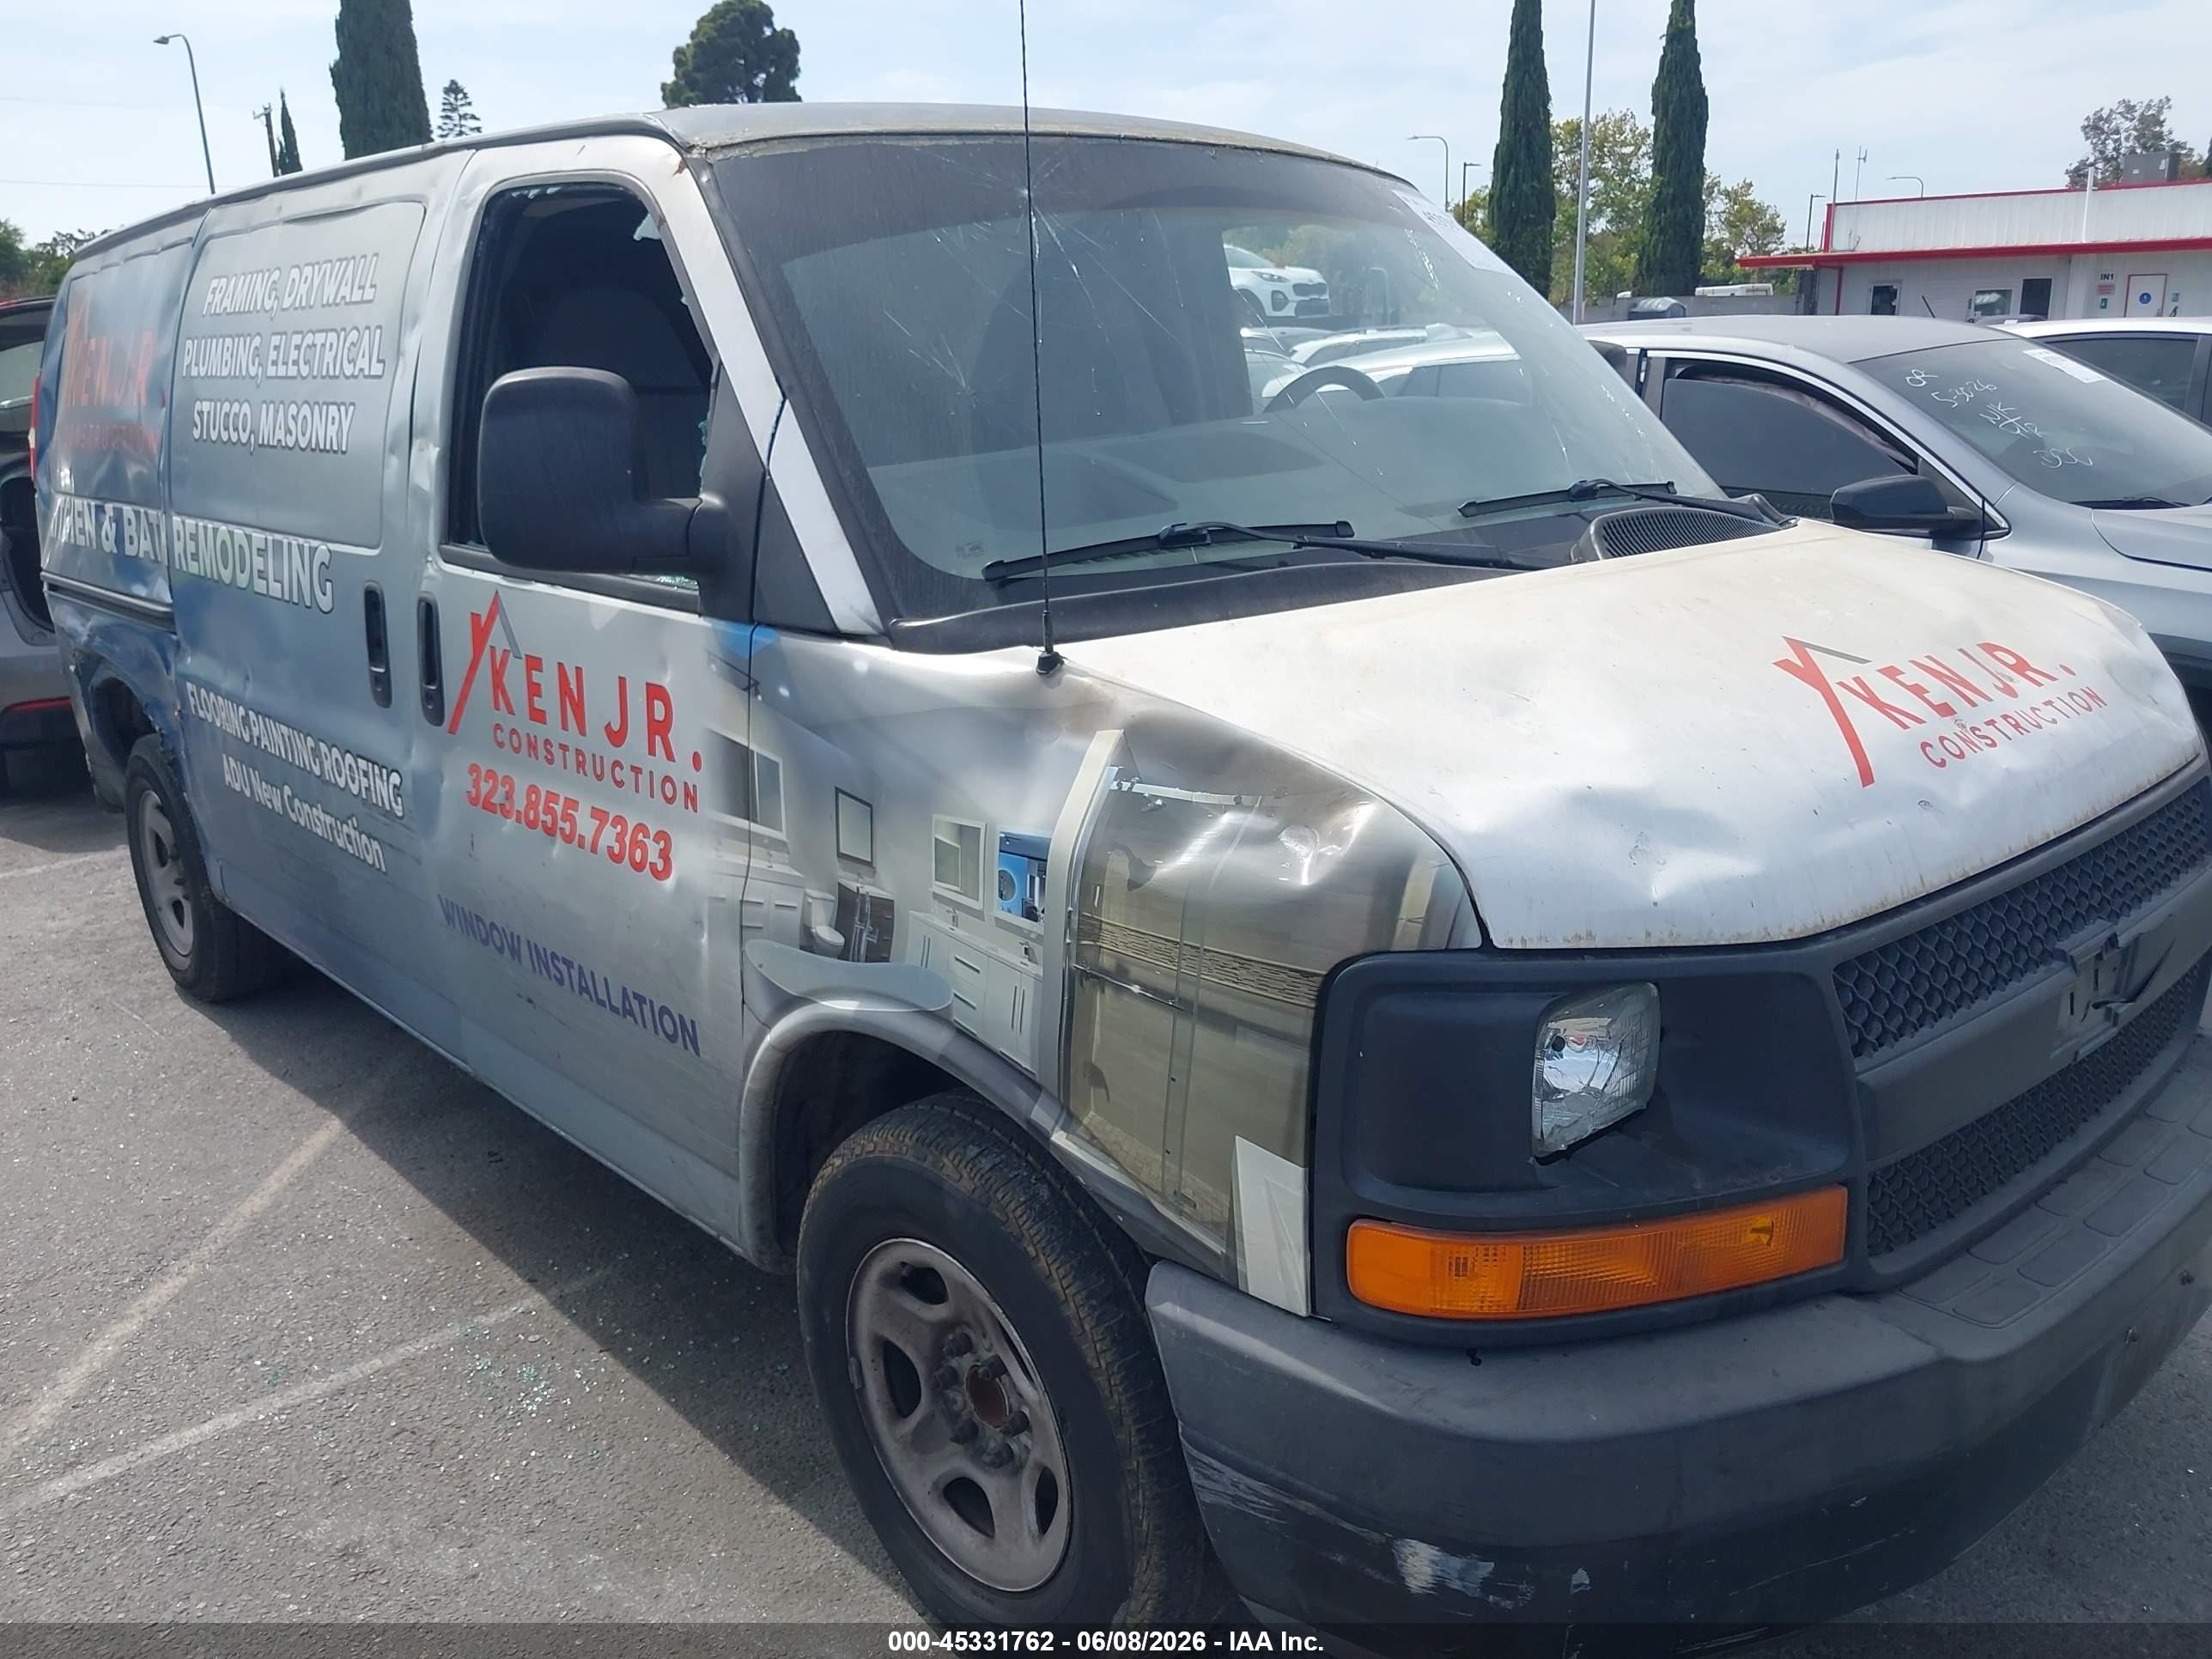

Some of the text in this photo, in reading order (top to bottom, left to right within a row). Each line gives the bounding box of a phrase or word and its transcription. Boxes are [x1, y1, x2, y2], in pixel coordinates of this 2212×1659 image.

[203, 254, 380, 319] FRAMING, DRYWALL
[182, 326, 386, 386] PLUMBING, ELECTRICAL
[192, 400, 356, 453] STUCCO, MASONRY
[101, 502, 118, 554] &
[173, 515, 334, 614] REMODELING
[185, 681, 404, 817] FLOORING PAINTING ROOFING
[494, 723, 698, 813] CONSTRUCTION
[1920, 686, 2108, 769] CONSTRUCTION
[222, 754, 387, 872] ADU New Construction
[467, 763, 673, 881] 323.855.7363
[437, 893, 702, 1058] WINDOW INSTALLATION
